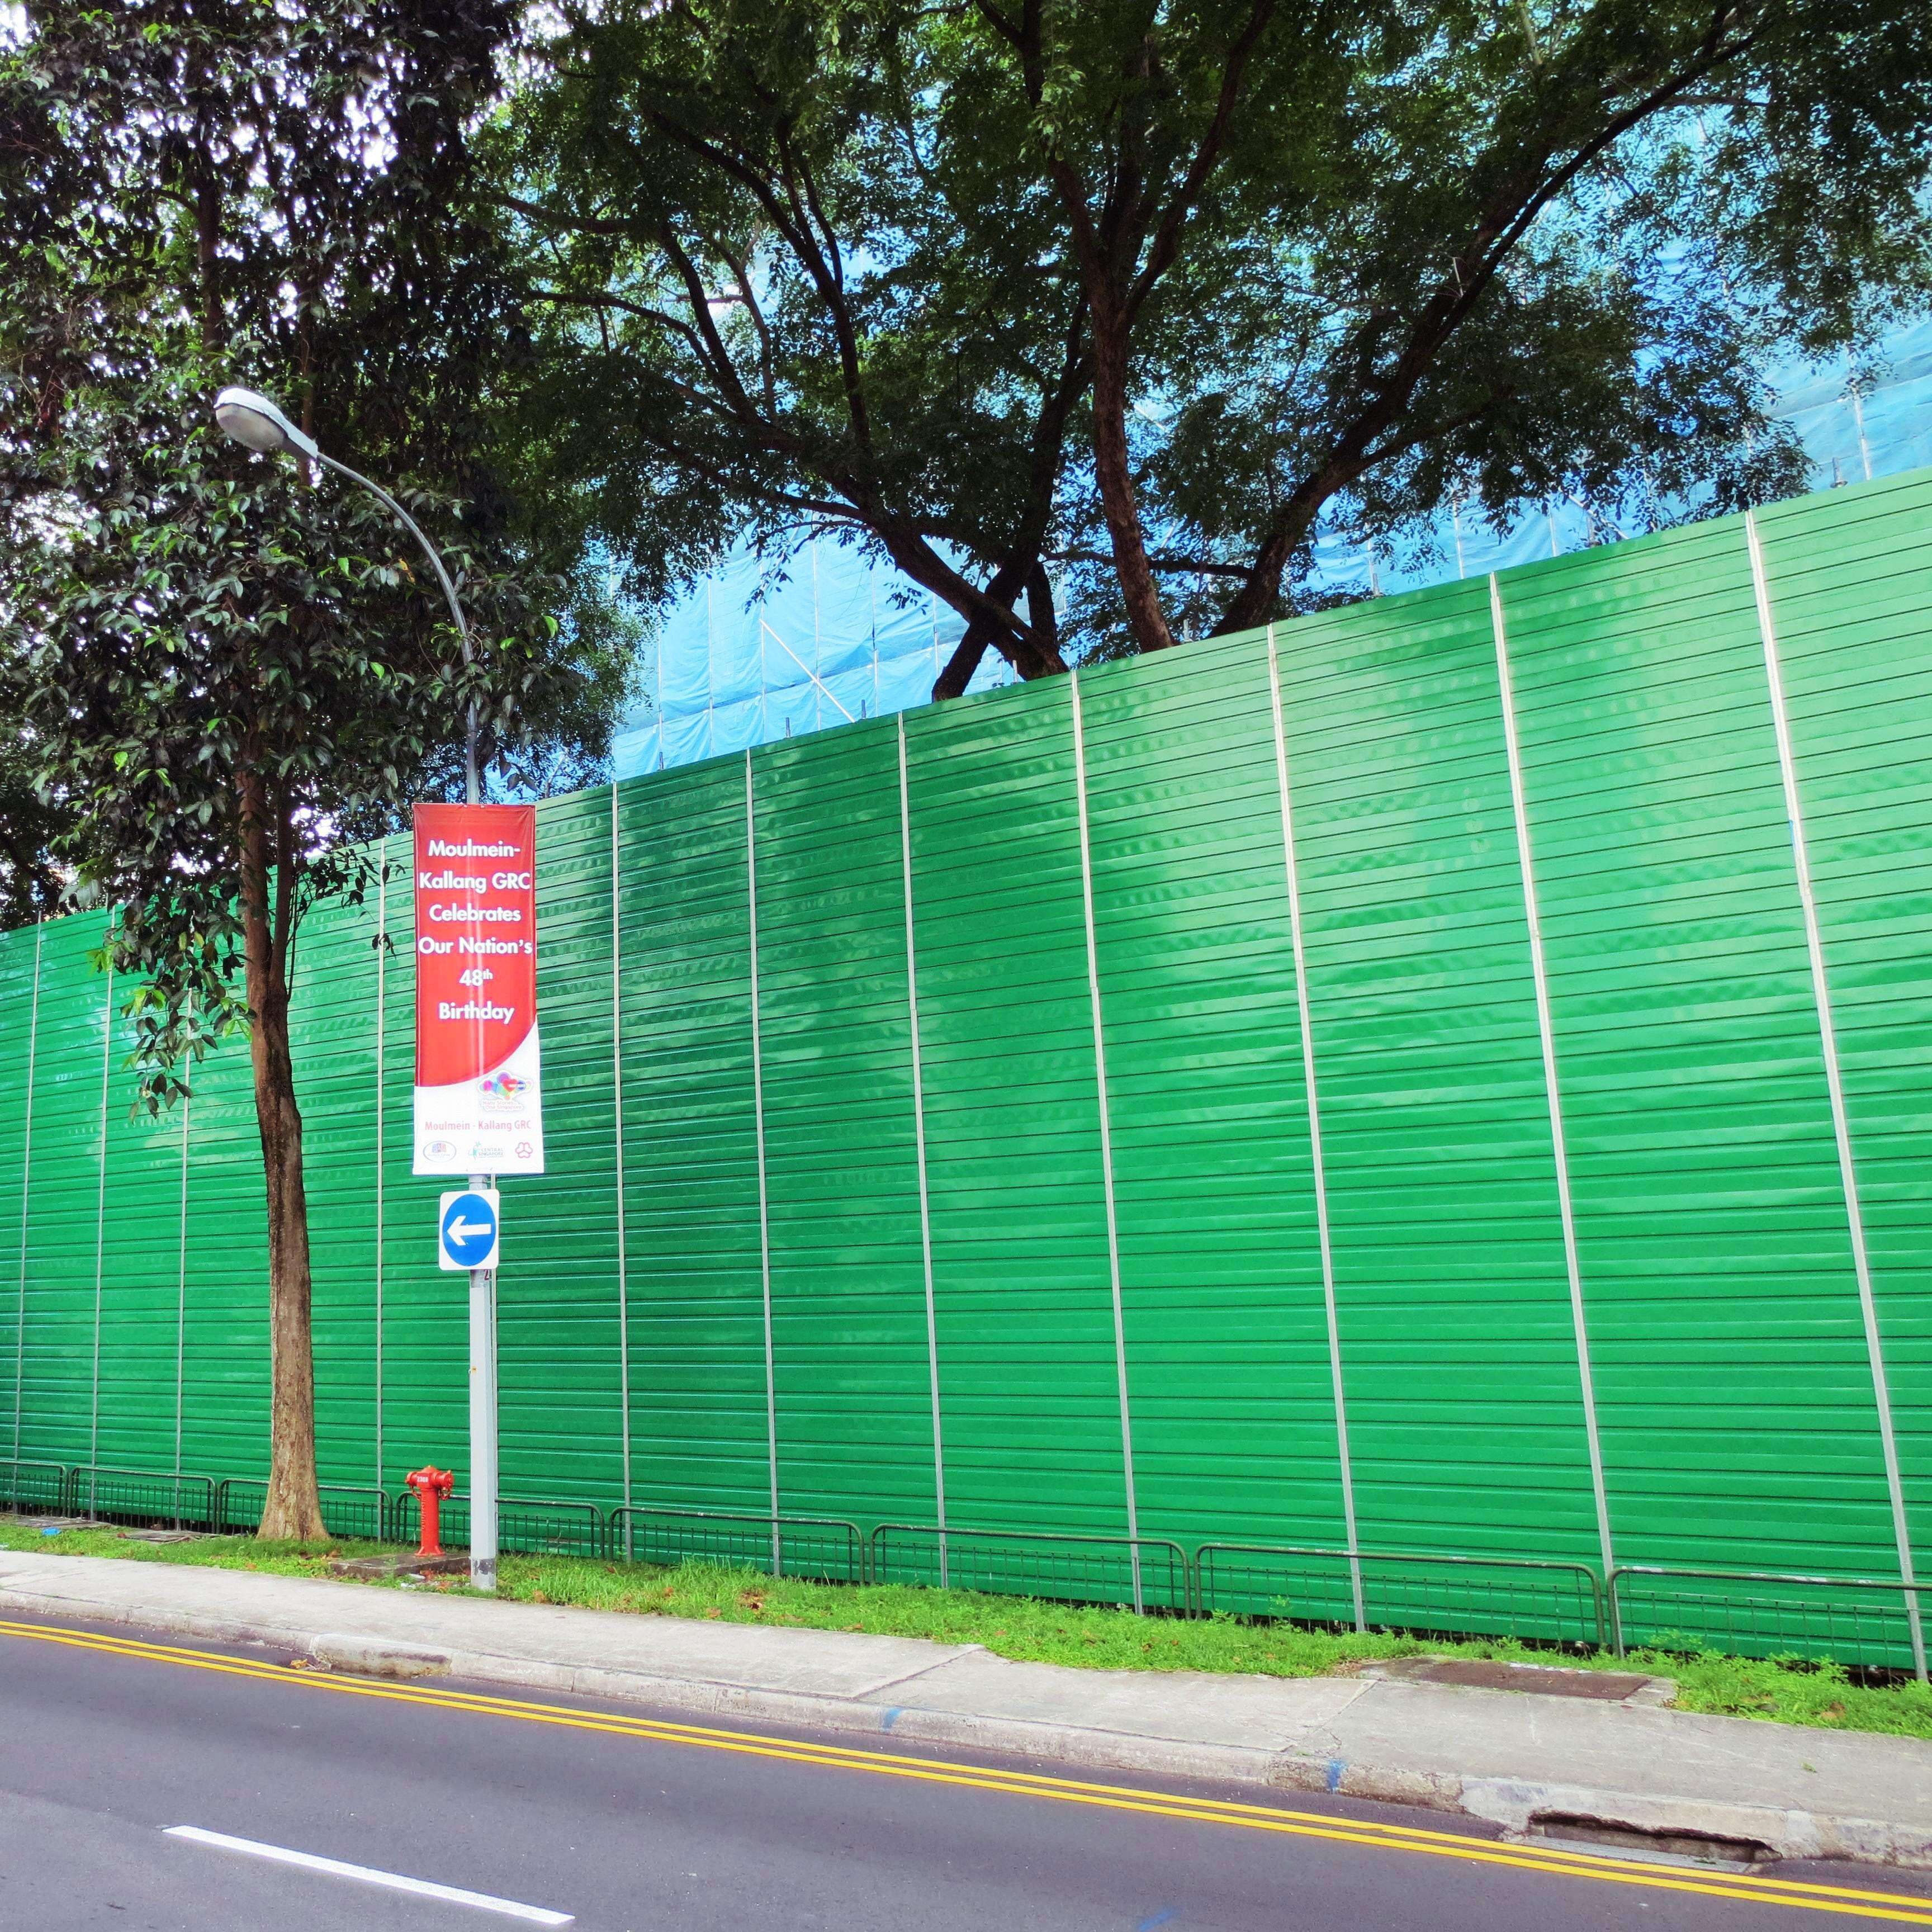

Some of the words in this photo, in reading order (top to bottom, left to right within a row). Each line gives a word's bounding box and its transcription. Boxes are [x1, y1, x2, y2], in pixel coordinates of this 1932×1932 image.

[429, 839, 520, 858] Moulmein-
[419, 870, 486, 894] Kallang
[492, 873, 531, 889] GRC
[429, 903, 521, 922] Celebrates
[419, 937, 453, 954] Our
[459, 936, 533, 954] Nation's
[459, 968, 493, 987] 48th
[439, 1000, 514, 1024] Birthday
[425, 1121, 470, 1130] Moulmein
[479, 1120, 512, 1132] Kallang
[514, 1120, 532, 1129] GRC
